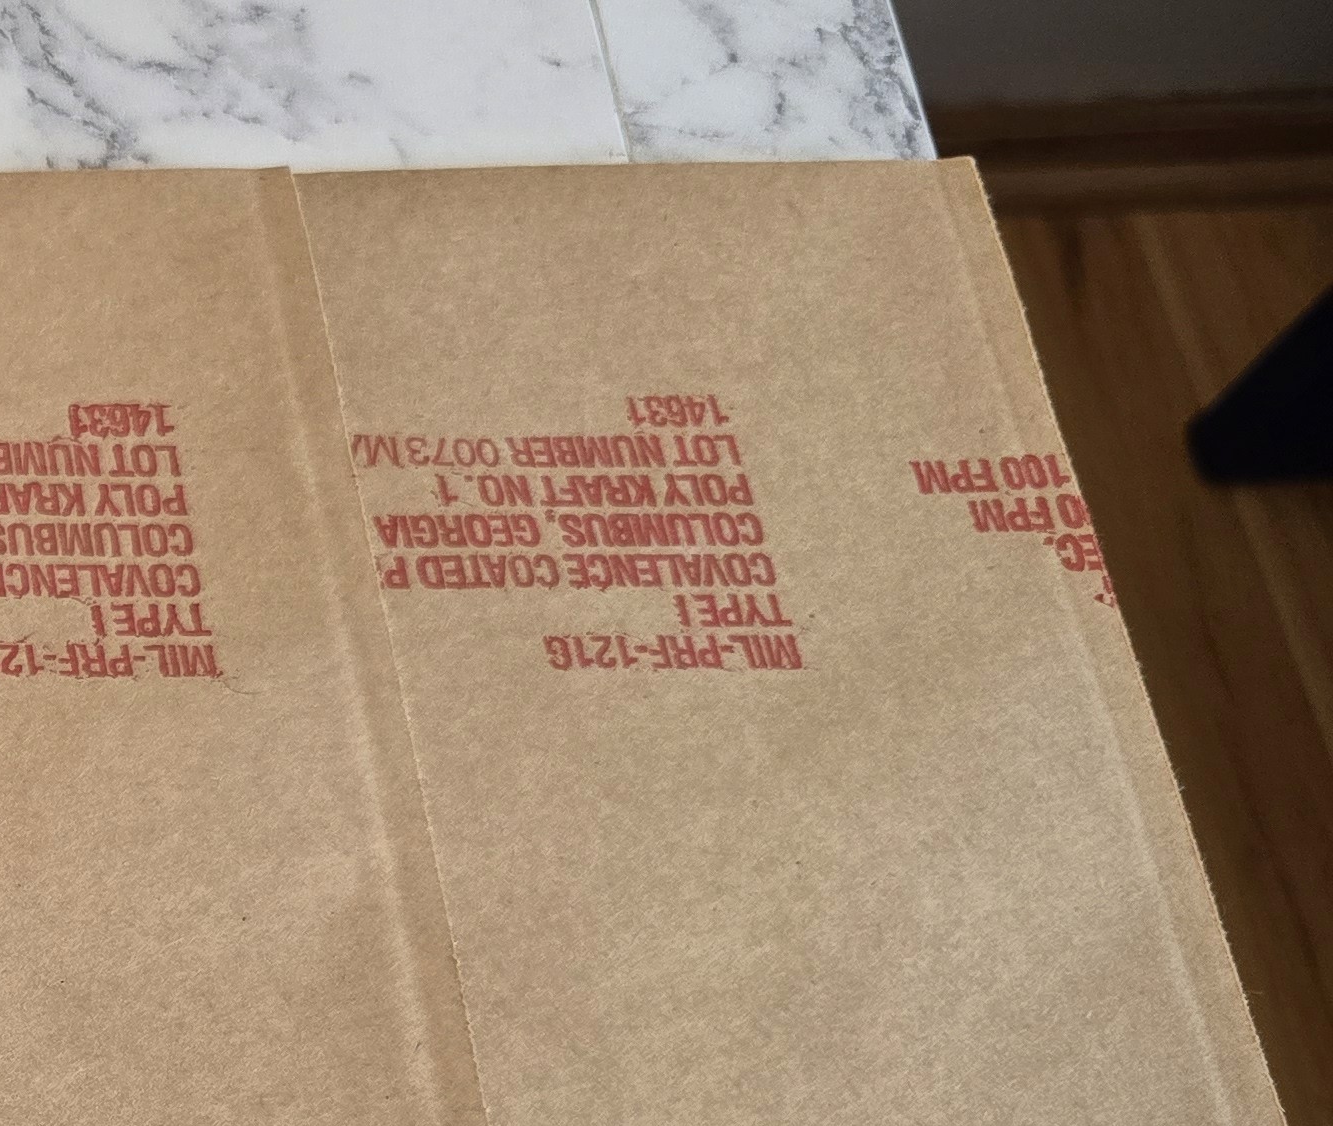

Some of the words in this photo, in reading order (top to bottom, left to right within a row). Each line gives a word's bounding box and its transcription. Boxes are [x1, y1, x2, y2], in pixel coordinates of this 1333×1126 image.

[629, 395, 729, 428] 14631
[110, 444, 180, 477] LOT
[405, 436, 501, 468] 0073
[508, 434, 666, 468] NUMBER
[675, 434, 741, 466] LOT
[911, 459, 999, 493] FPM
[1001, 454, 1070, 490] 100
[96, 483, 187, 516] POLY
[467, 475, 533, 506] NO.
[544, 475, 656, 506] KRAFT
[665, 474, 752, 506] POLY
[374, 513, 541, 548] GEORGIA
[547, 511, 763, 546] COLUMBUS,
[970, 497, 1055, 532] FPM
[416, 554, 560, 589] COATED
[565, 553, 776, 589] COVALENCE
[111, 603, 212, 637] TYPE
[694, 593, 792, 628] TYPE
[544, 634, 802, 670] MIL-PRF-121G
